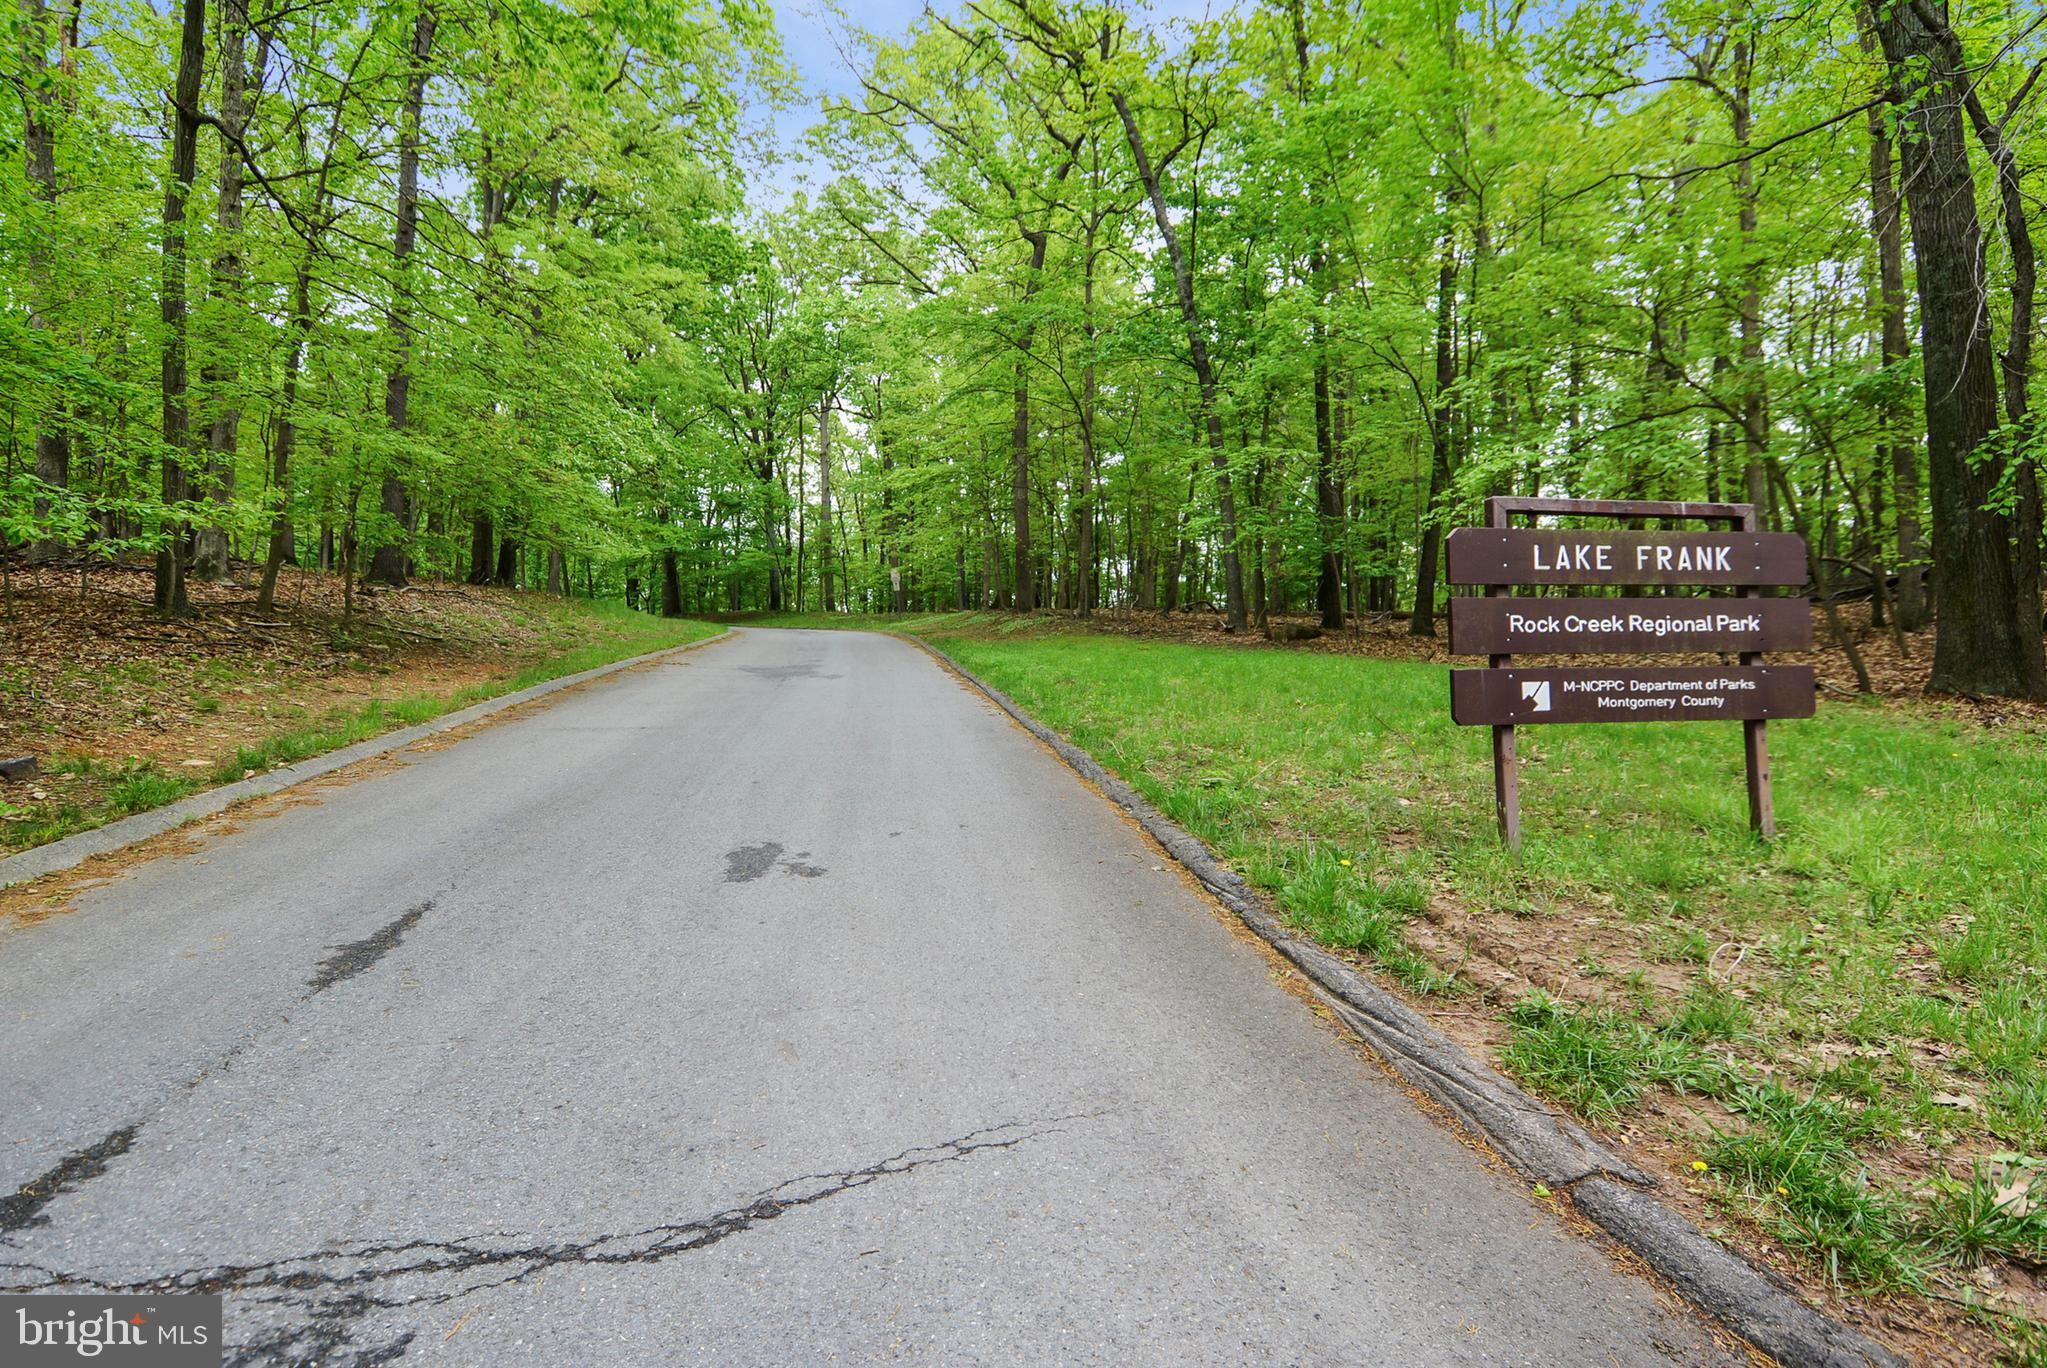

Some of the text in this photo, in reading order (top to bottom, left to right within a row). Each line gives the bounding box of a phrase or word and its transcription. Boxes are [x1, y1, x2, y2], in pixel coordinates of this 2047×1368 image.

[1533, 544, 1732, 572] LAKE FRANK
[1510, 614, 1761, 636] Rock Creek Regional Park
[1563, 678, 1756, 694] M-NCPPC Department of Parks
[1598, 695, 1725, 711] Montgomery County
